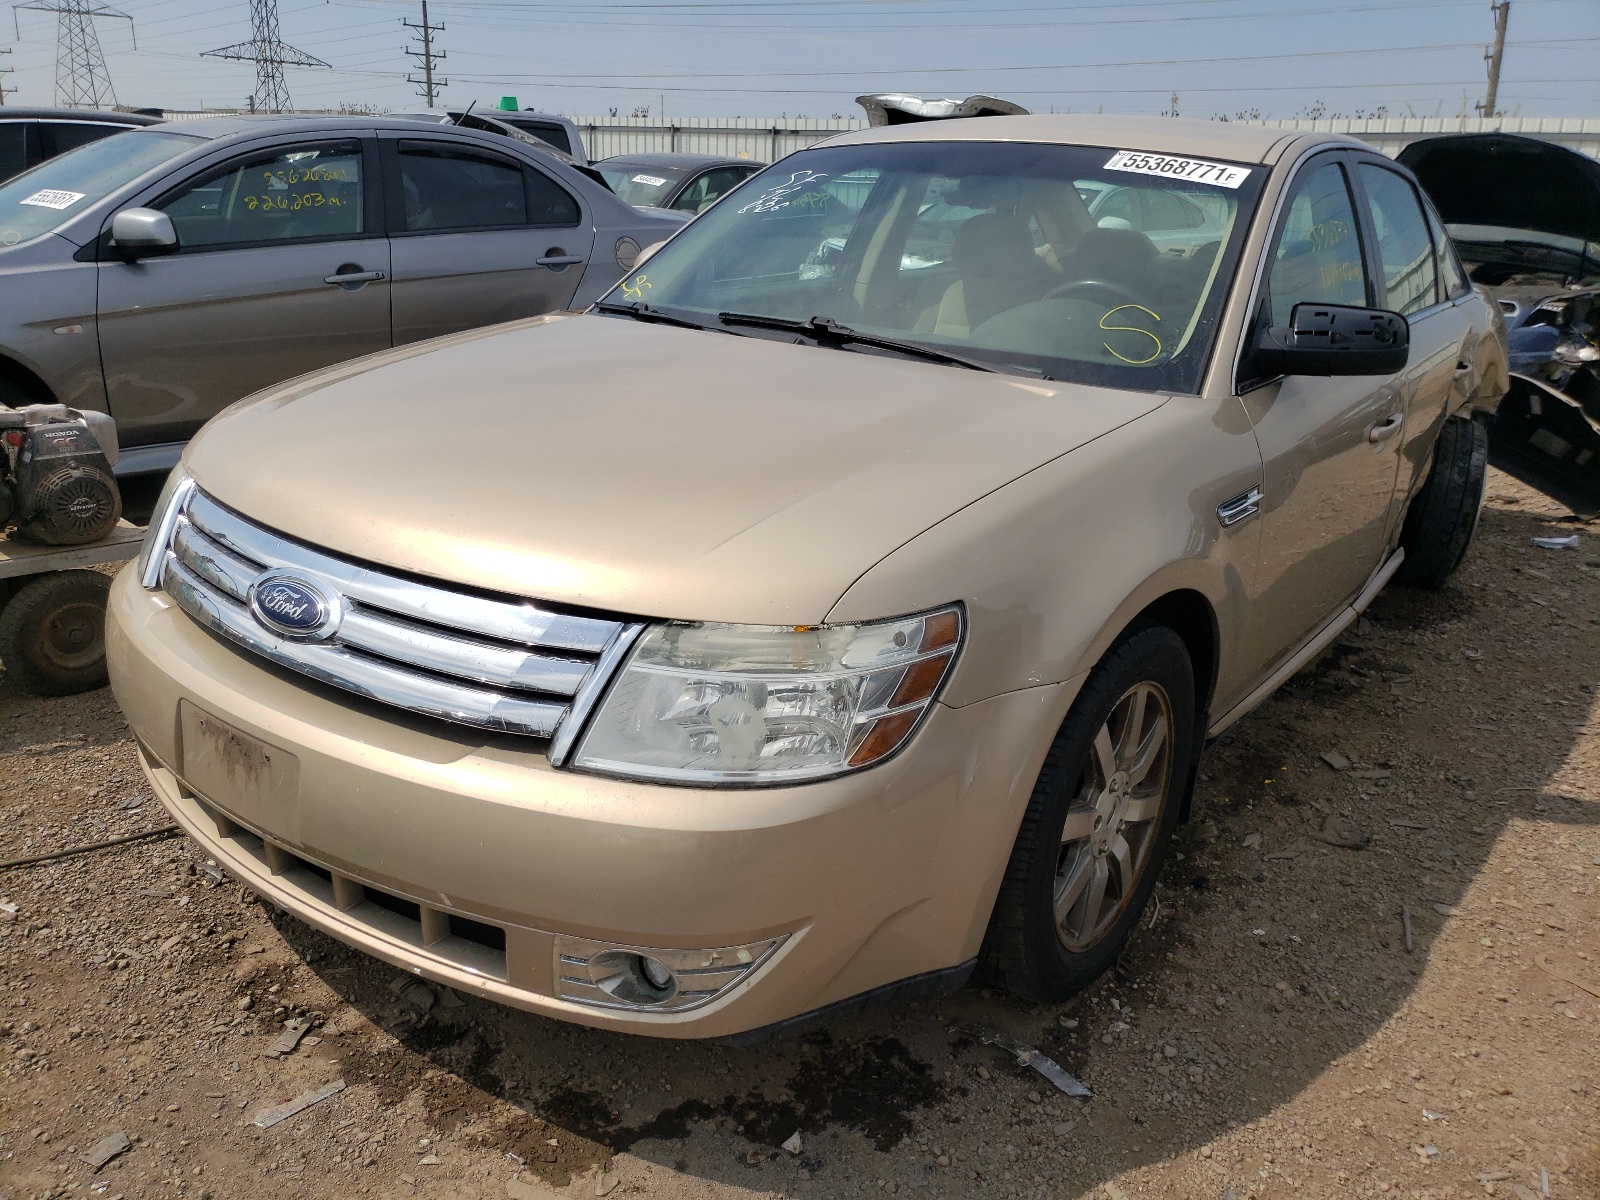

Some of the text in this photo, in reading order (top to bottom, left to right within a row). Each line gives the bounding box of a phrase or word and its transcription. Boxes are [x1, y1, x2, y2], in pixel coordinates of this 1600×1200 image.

[1122, 153, 1229, 181] 55368771
[44, 430, 80, 438] HONDA
[264, 586, 309, 620] Ford
